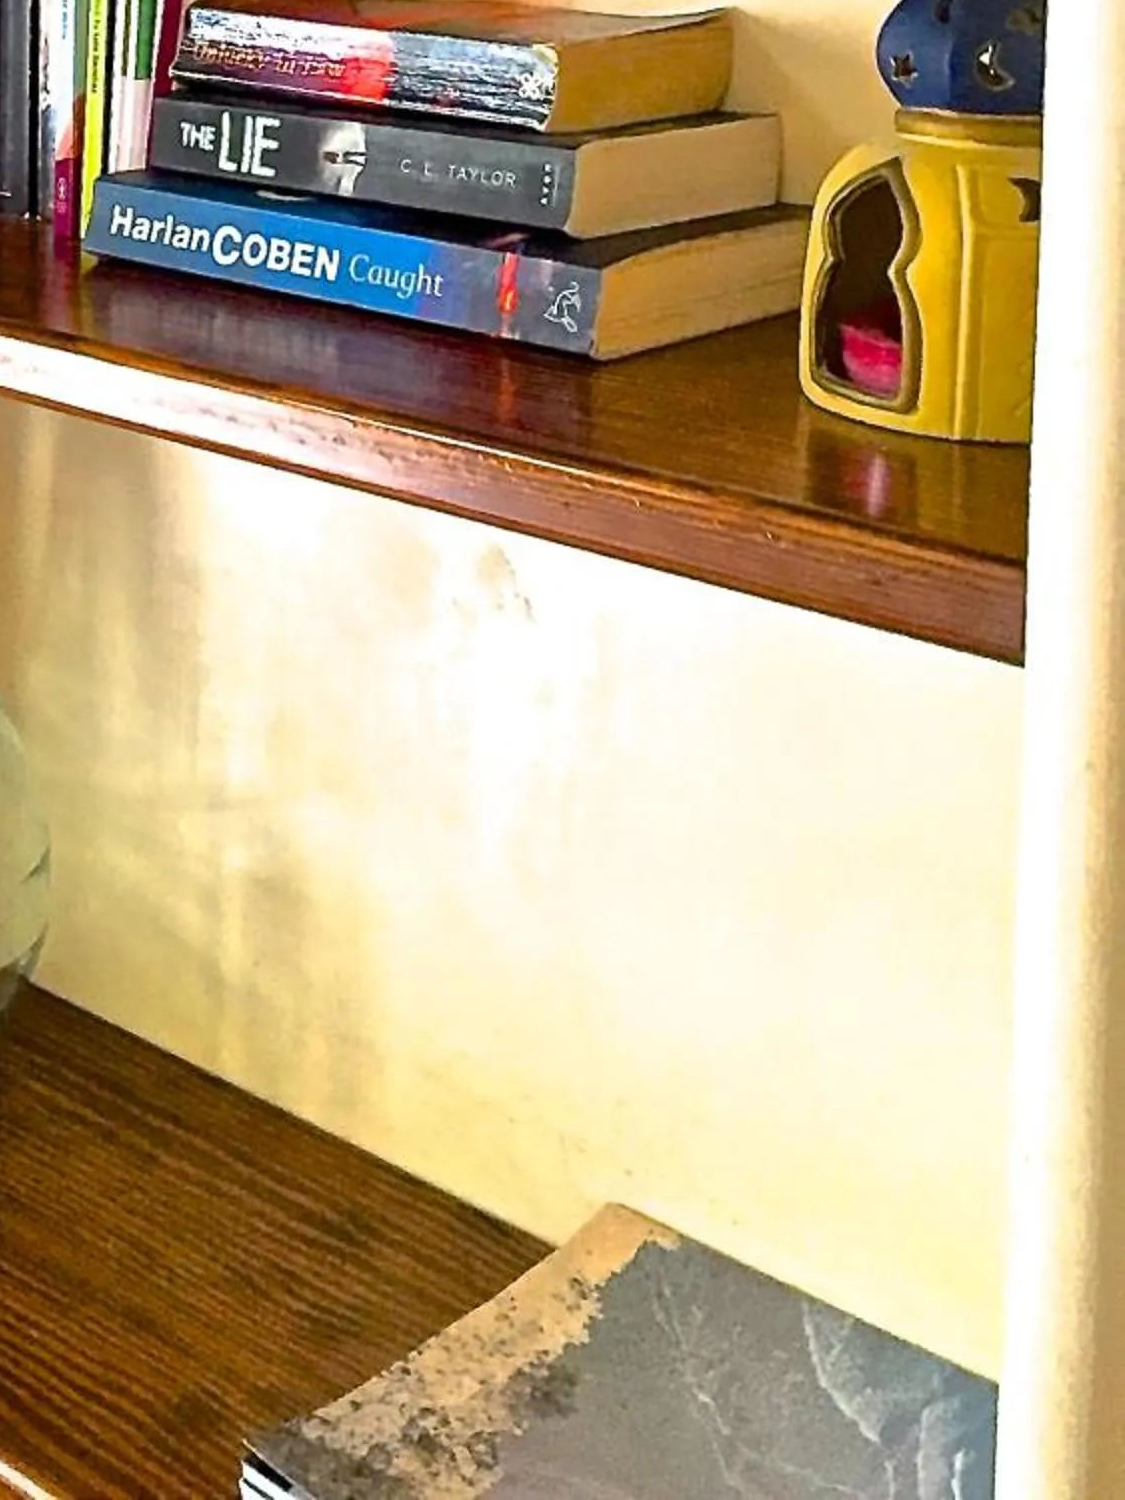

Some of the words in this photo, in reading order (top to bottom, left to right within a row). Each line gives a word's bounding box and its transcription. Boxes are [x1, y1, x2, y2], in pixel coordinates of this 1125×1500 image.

[180, 122, 217, 151] THE
[218, 111, 283, 178] LIE
[448, 164, 517, 189] TAYLOR
[110, 204, 211, 253] Harlan
[211, 225, 342, 282] COBEN
[349, 253, 444, 300] Caught
